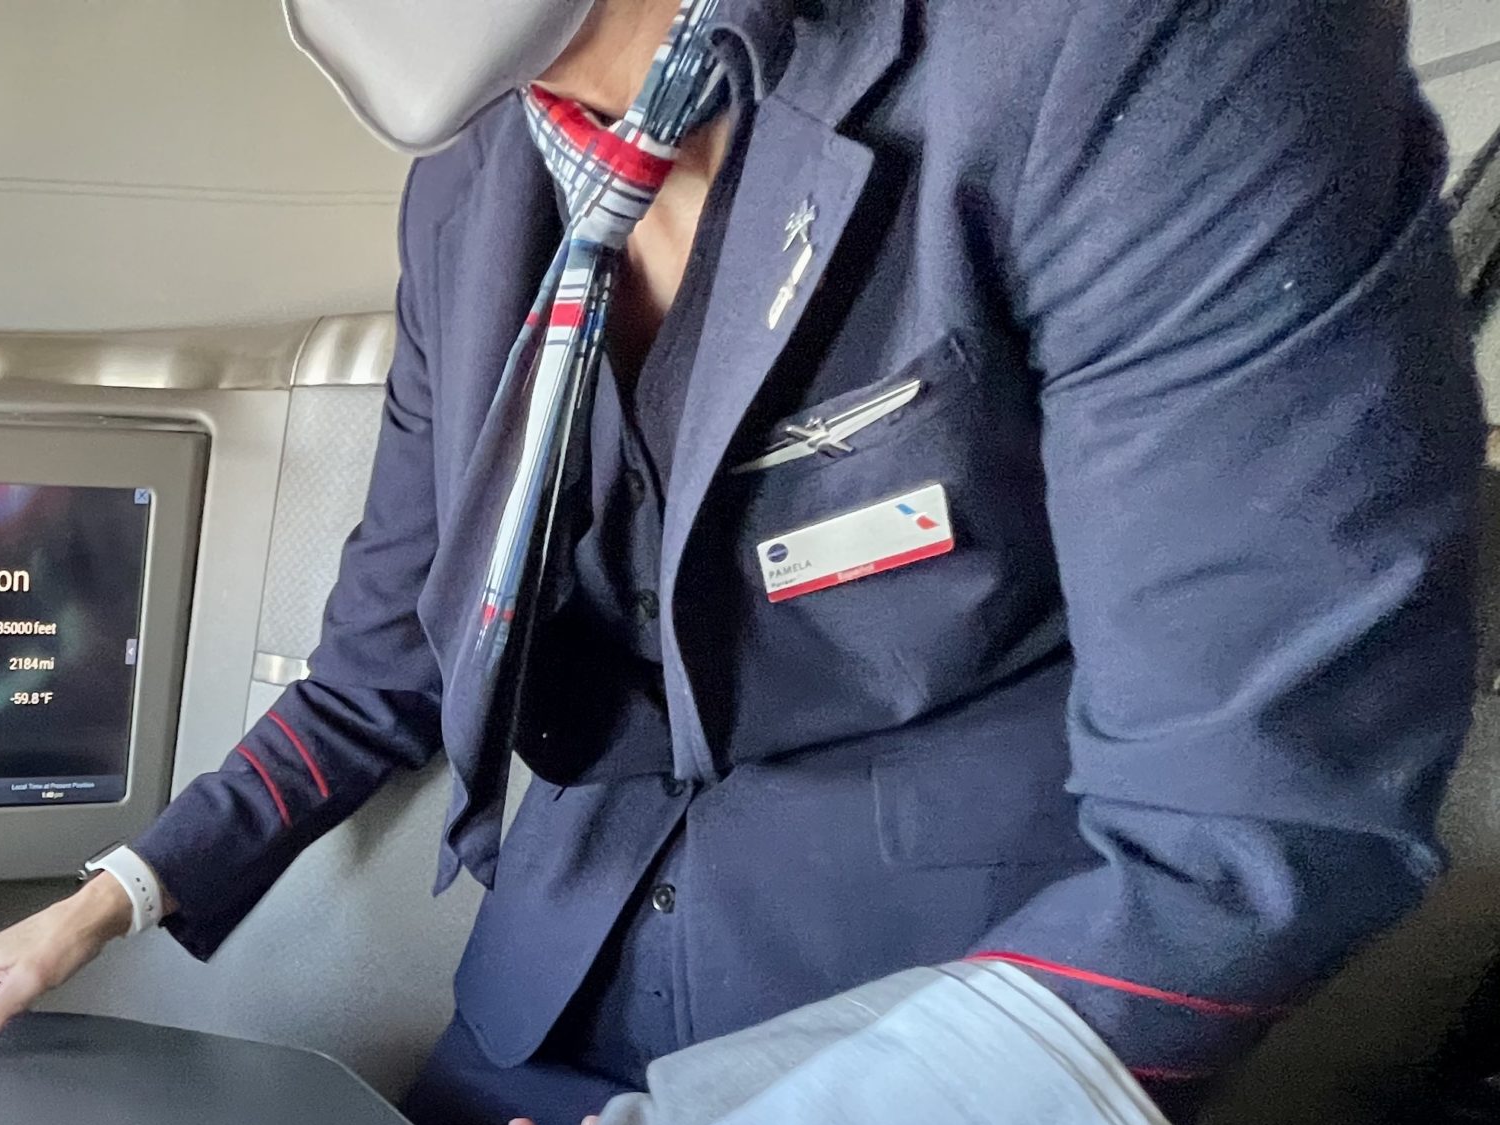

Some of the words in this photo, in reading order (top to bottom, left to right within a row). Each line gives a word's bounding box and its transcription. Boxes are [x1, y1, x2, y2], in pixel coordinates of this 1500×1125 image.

[768, 560, 812, 578] PAMELA
[34, 621, 57, 635] feet
[9, 657, 38, 670] 2184
[39, 657, 55, 670] mi
